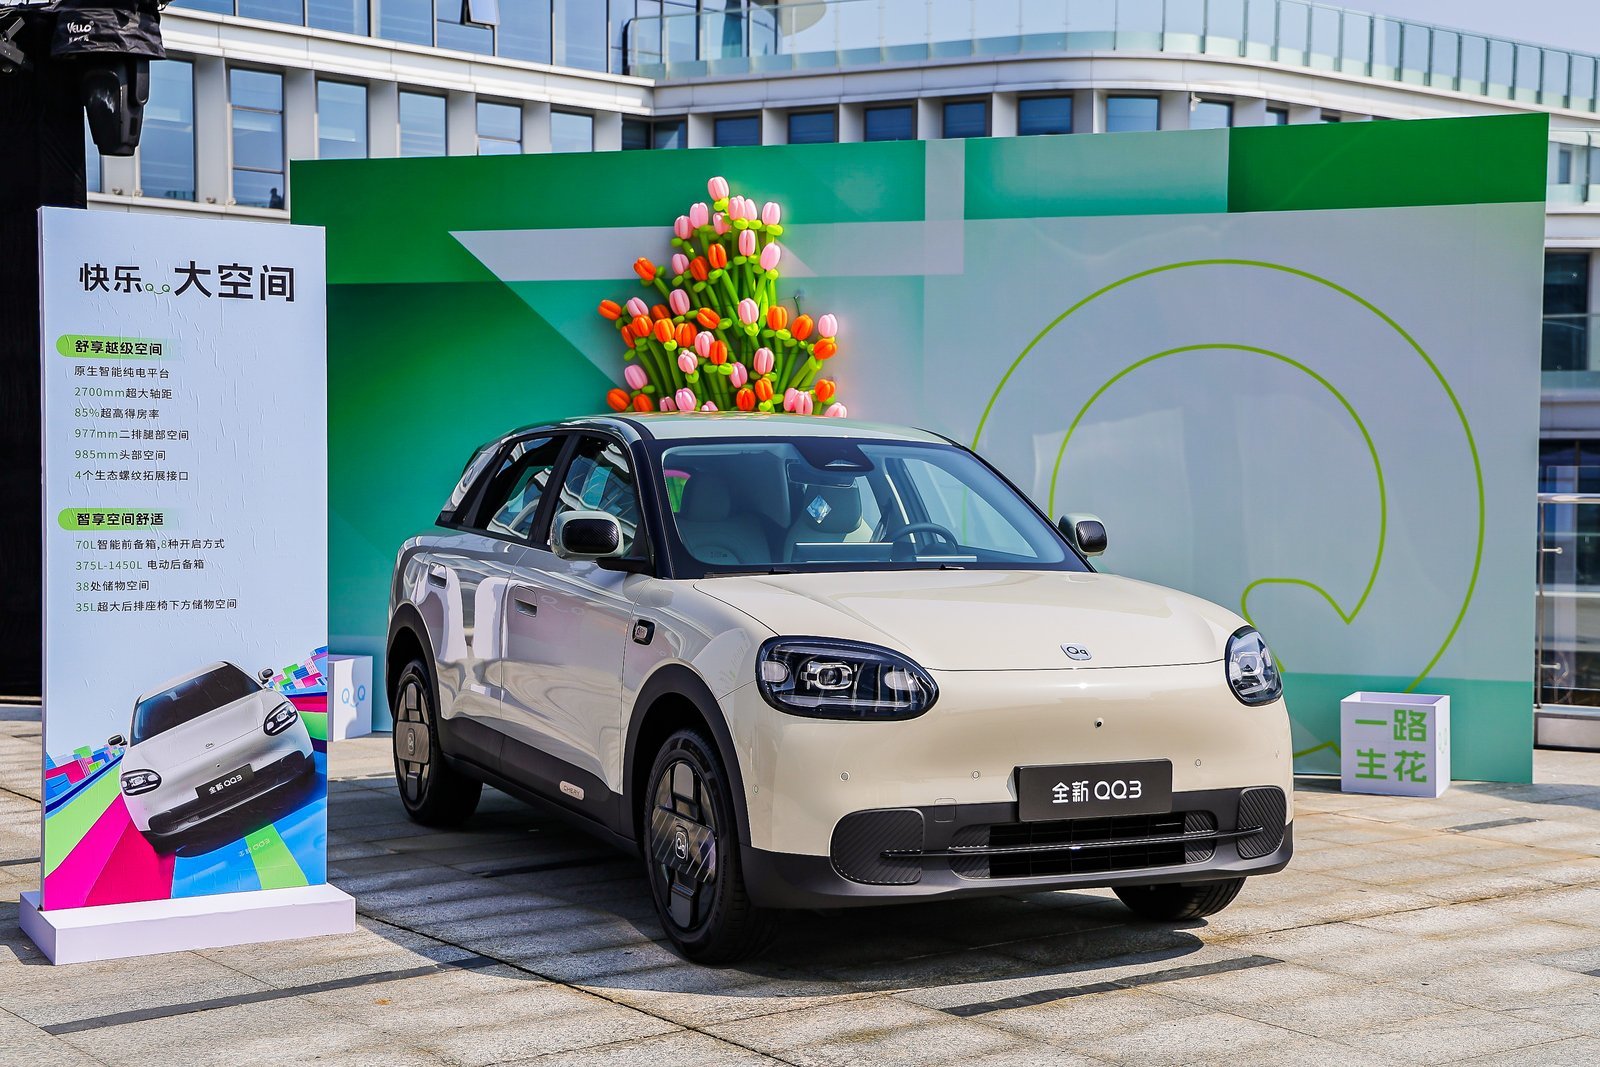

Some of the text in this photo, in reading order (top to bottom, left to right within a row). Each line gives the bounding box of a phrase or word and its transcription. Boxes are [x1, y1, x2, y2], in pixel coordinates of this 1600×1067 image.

[79, 263, 143, 293] 快乐
[174, 260, 295, 302] 大空间
[75, 339, 163, 356] 舒享越级空间
[74, 365, 170, 379] 原生智能纯电平台
[74, 386, 173, 400] 2700mm超大轴距
[74, 407, 160, 420] 85%超高得房率
[74, 428, 189, 441] 977mm二排腿部空间
[74, 449, 166, 461] 985mm头部空间
[75, 469, 189, 482] 4个生态螺纹拓展接口
[76, 512, 164, 526] 智享空间舒适
[75, 558, 205, 571] 375L-1450L 电动后备箱
[75, 580, 150, 592] 38处储物空间
[75, 598, 238, 613] 35L超大后排座椅下方储物空间
[1355, 709, 1427, 741] 一路
[1355, 748, 1427, 782] 生花
[1051, 780, 1090, 804] 全新
